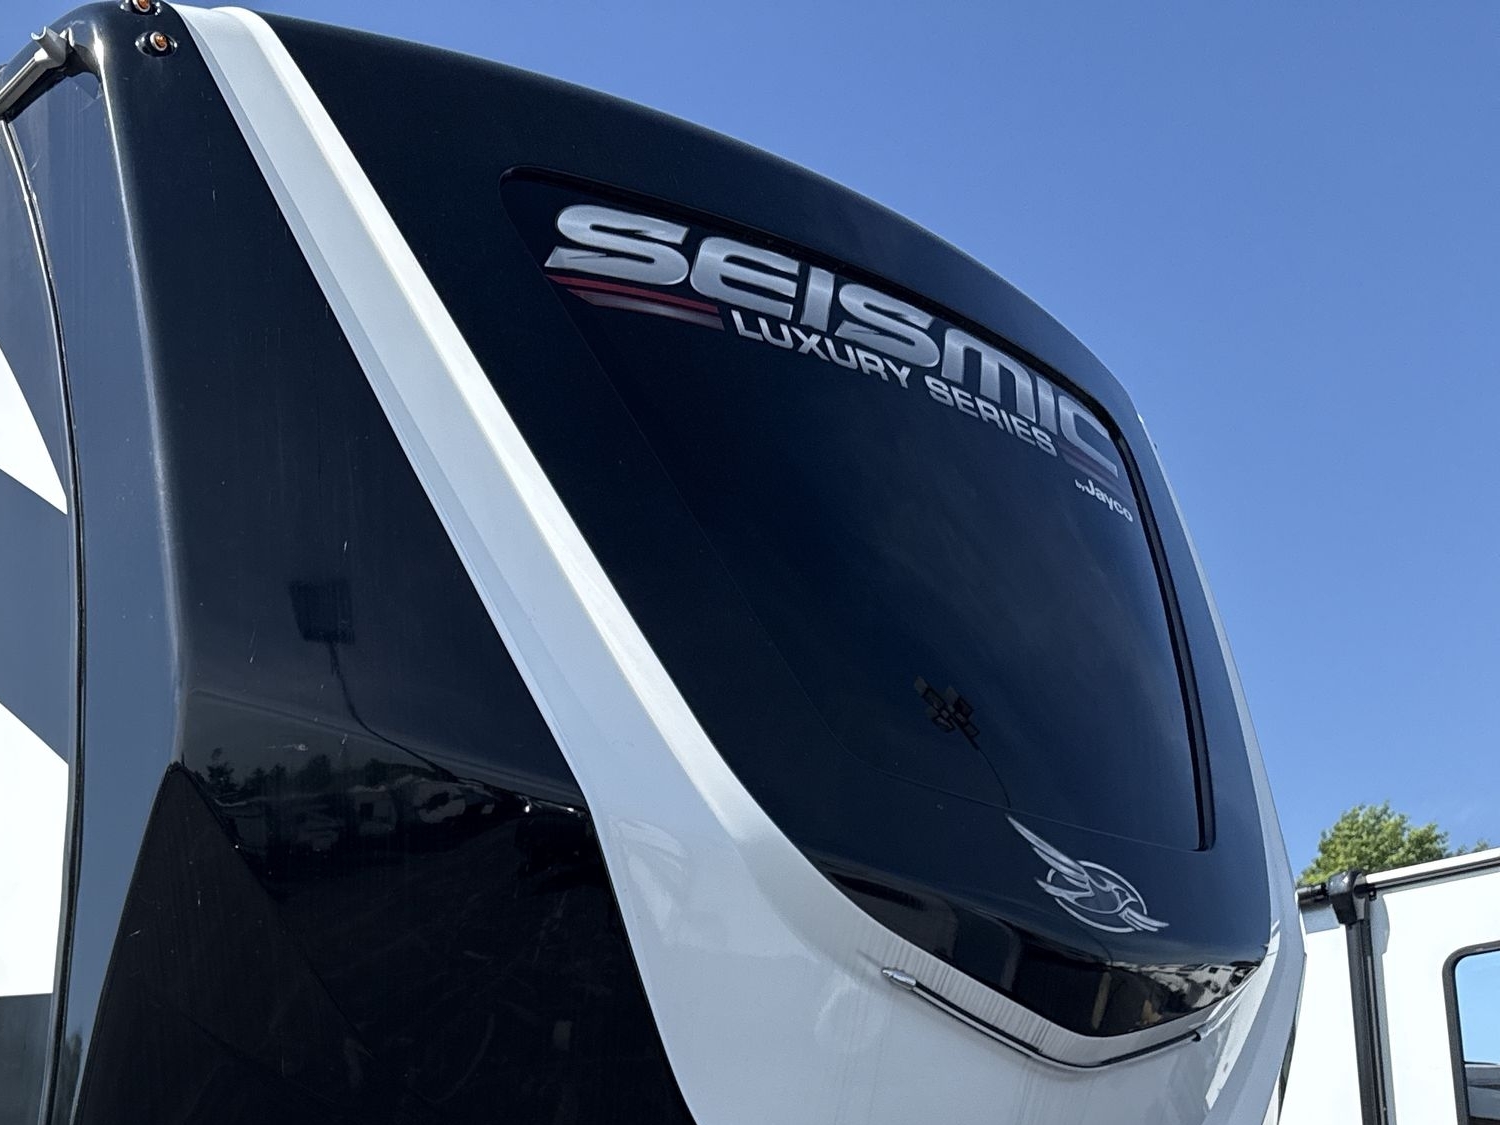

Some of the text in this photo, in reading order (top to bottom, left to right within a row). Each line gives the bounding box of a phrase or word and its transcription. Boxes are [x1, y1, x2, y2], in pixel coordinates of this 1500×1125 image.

[544, 204, 1119, 478] SEISMIC
[731, 309, 1058, 457] LUXURY SERIES
